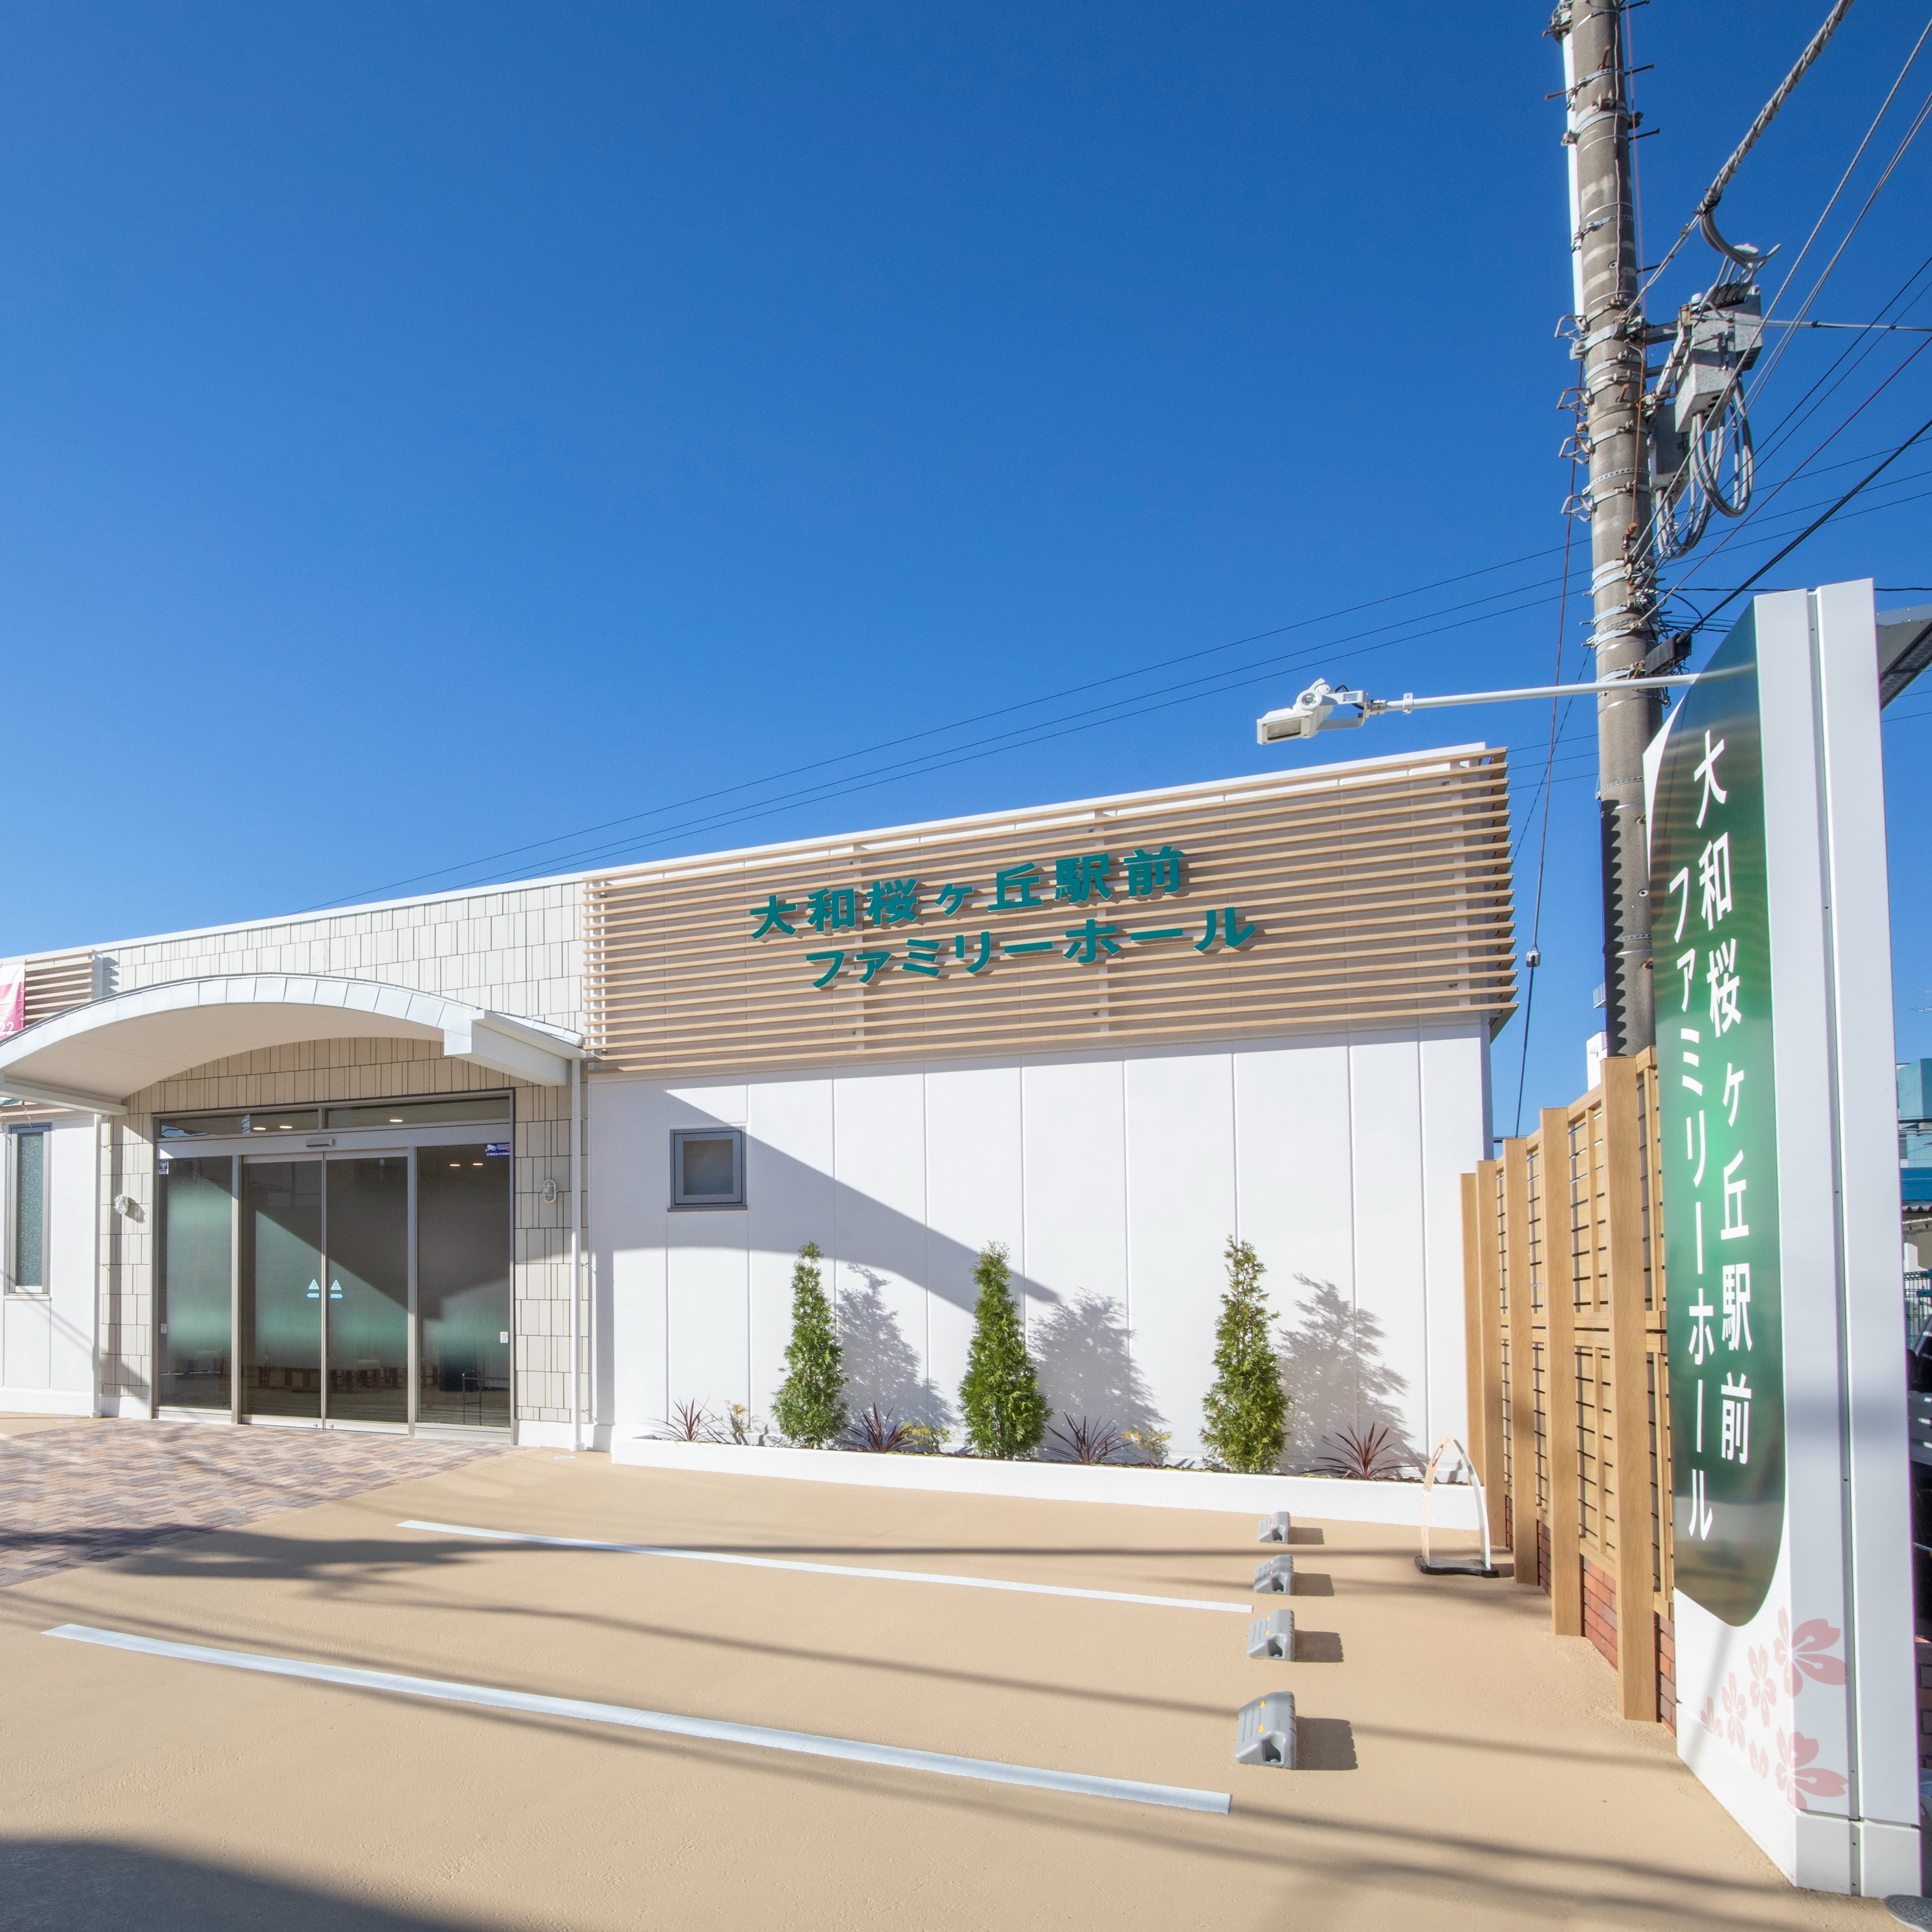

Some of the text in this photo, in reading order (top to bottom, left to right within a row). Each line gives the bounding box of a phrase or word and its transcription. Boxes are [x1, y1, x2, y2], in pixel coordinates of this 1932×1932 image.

[750, 845, 1183, 939] 大和桜ヶ丘駅前
[806, 907, 1256, 988] ファミリーホール
[1669, 867, 1714, 1541] ファミリーホール
[1694, 730, 1752, 1465] 大和桜ヶ丘駅前
